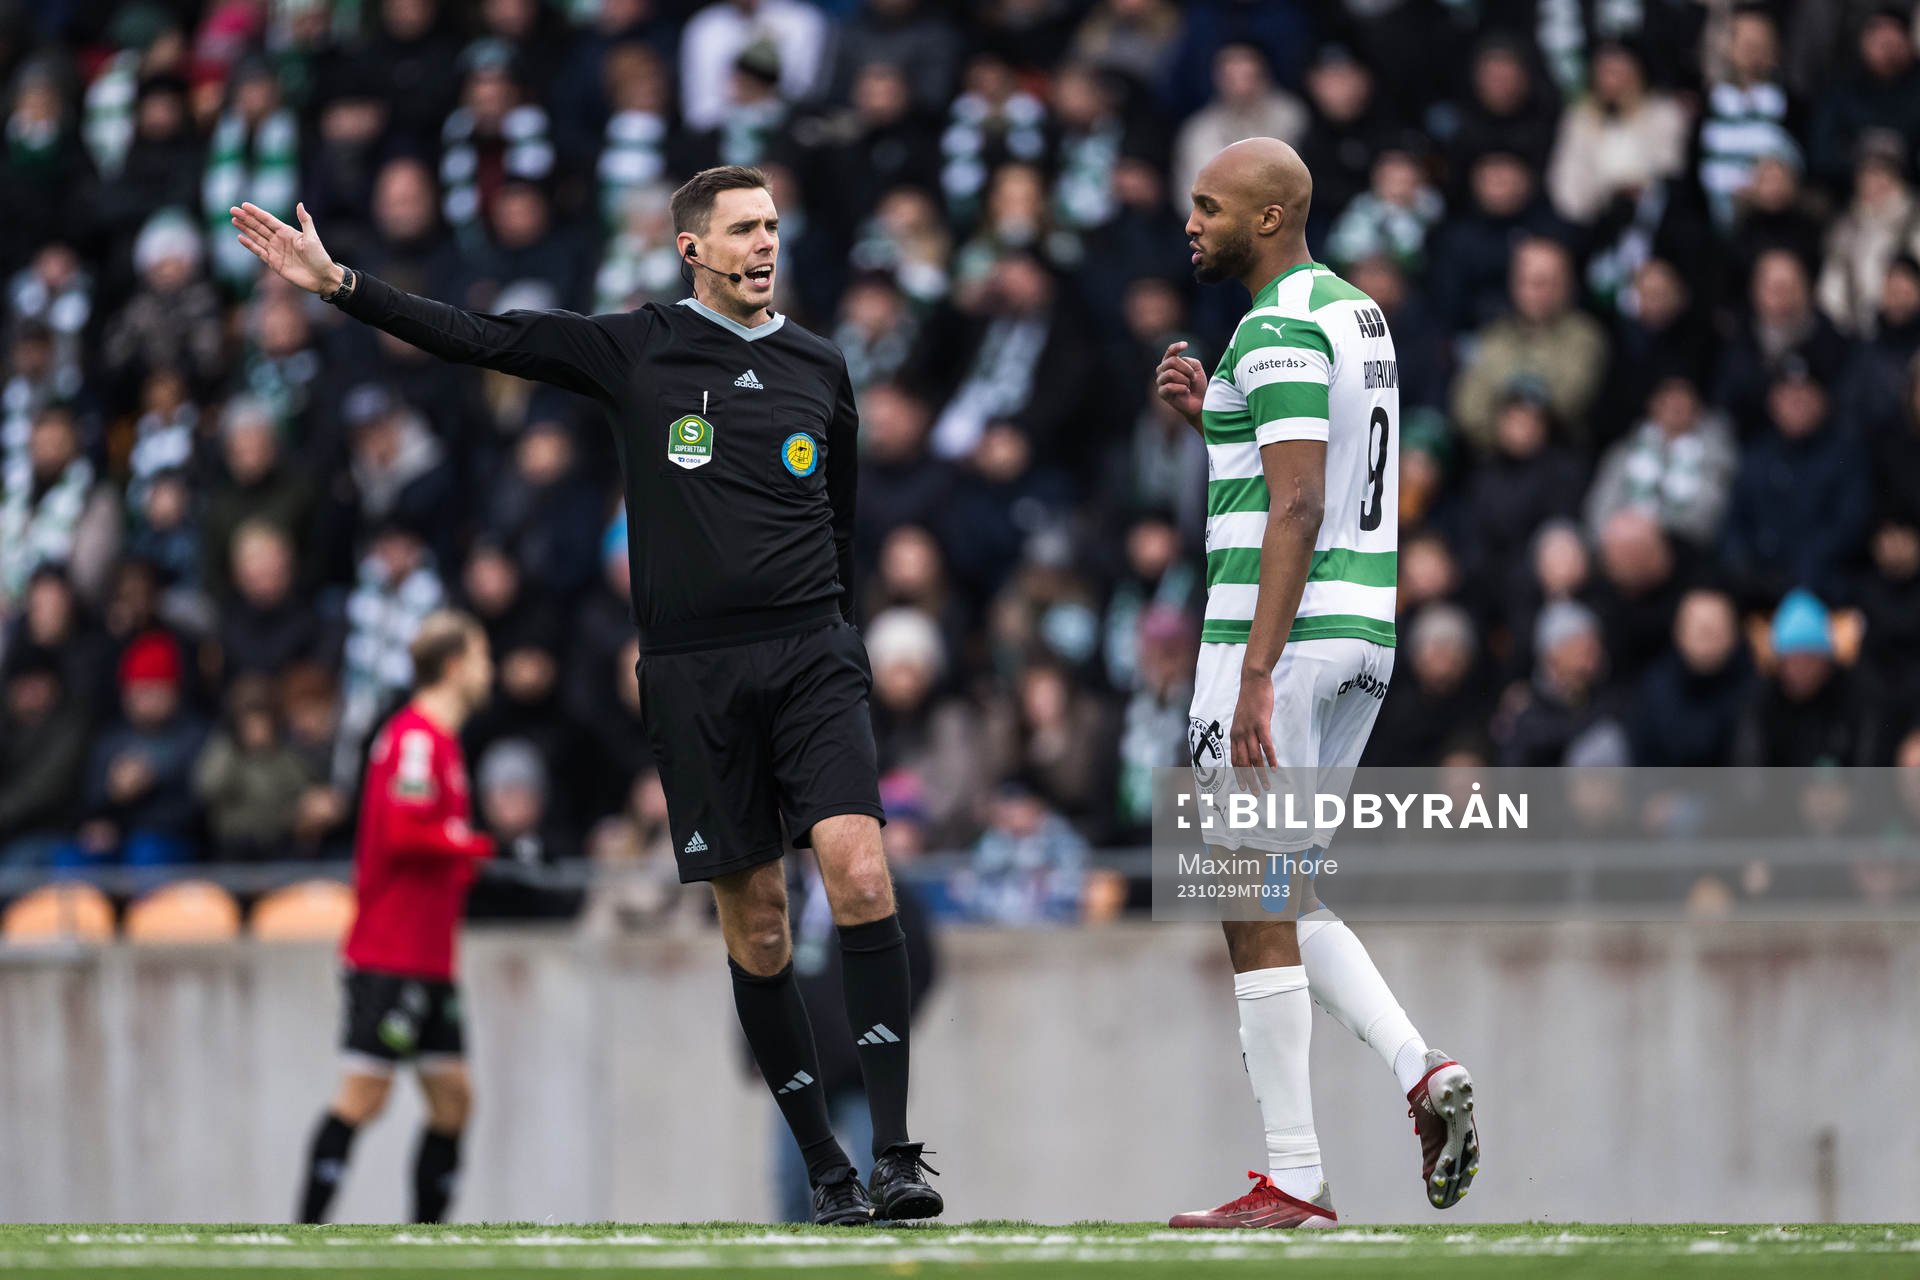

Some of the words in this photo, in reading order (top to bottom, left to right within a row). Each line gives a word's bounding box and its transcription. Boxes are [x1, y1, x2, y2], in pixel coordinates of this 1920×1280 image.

[1354, 308, 1386, 339] ABB
[734, 380, 764, 390] adidas
[683, 421, 699, 441] S
[674, 444, 707, 454] SUPERETTAN
[1359, 406, 1390, 532] 9
[684, 843, 708, 854] adidas
